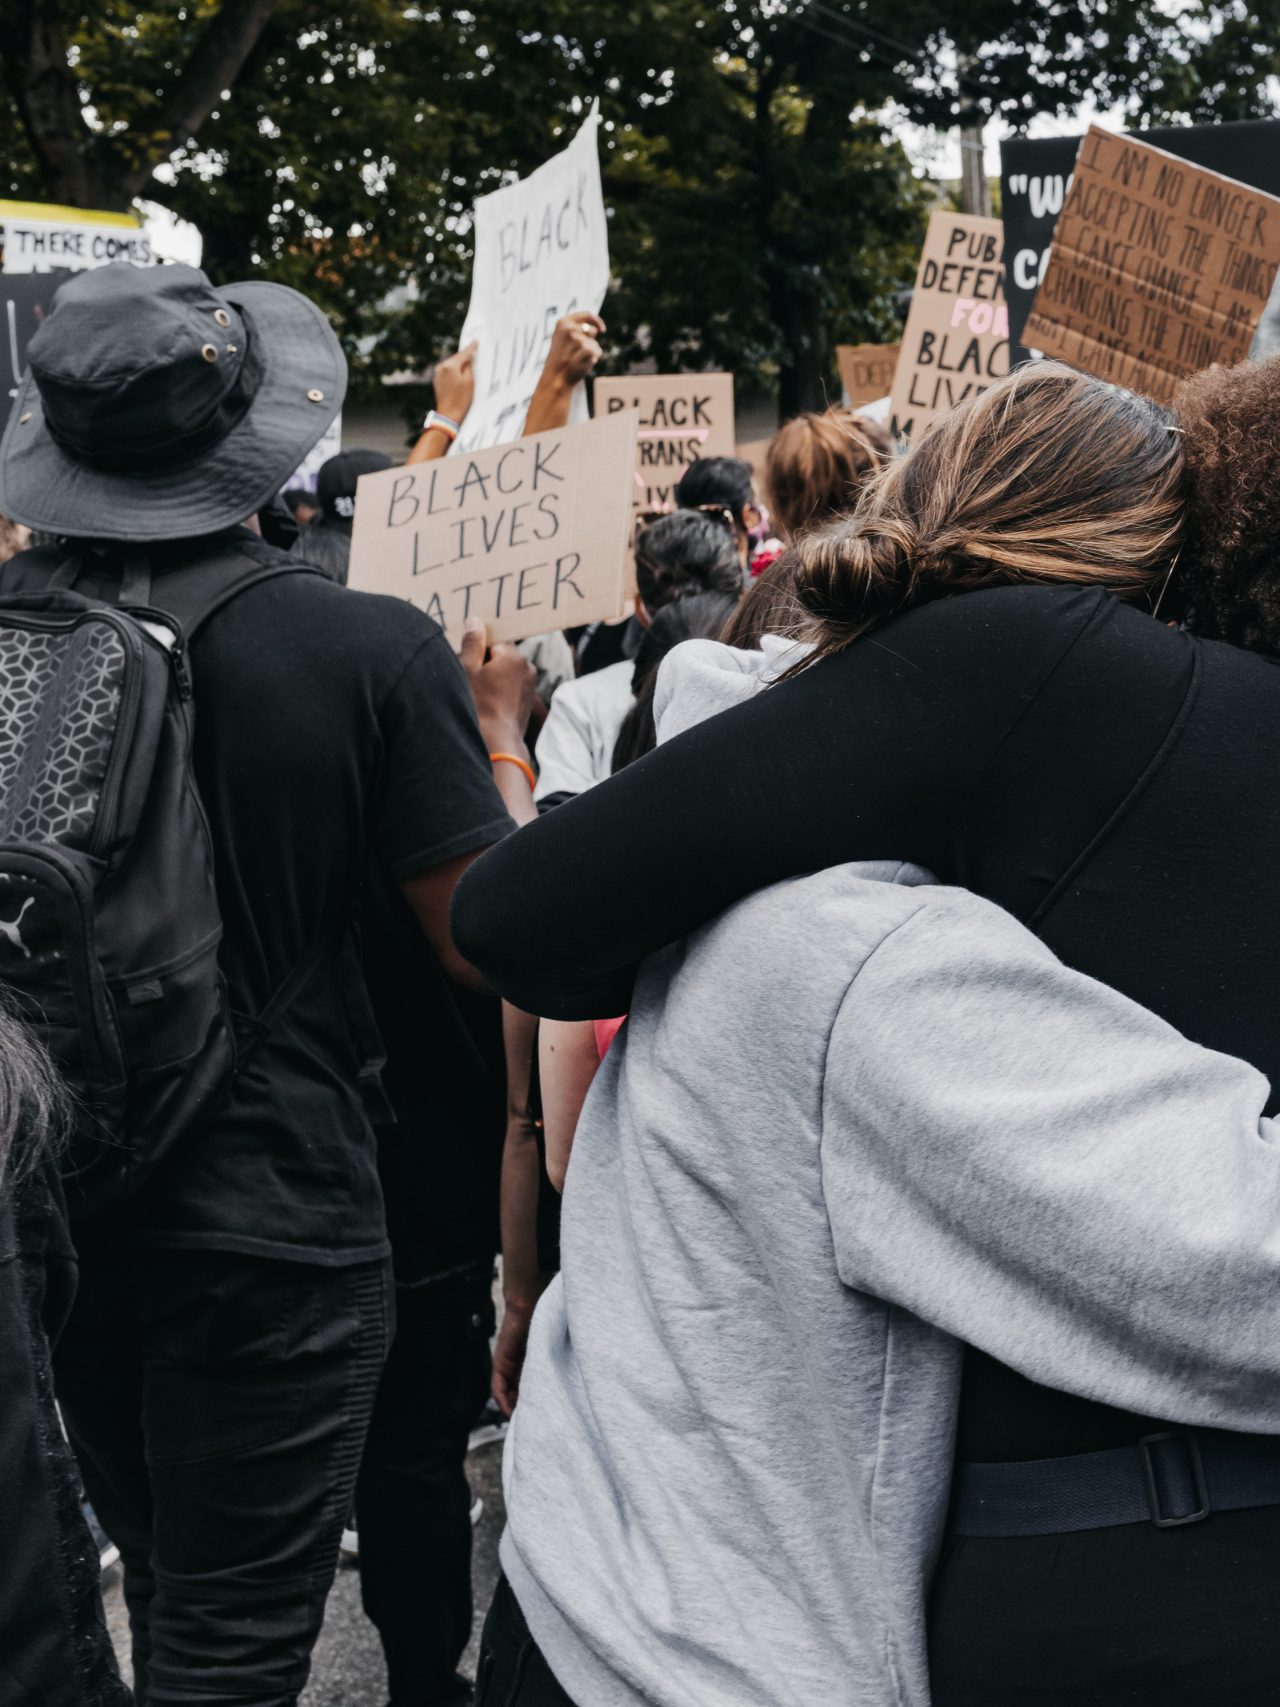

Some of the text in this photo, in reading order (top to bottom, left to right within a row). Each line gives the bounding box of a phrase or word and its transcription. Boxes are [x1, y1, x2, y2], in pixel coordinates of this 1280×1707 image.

[500, 171, 589, 293] BLACK
[1080, 132, 1269, 248] I AM NO LONGER
[14, 230, 85, 257] THERE
[92, 234, 151, 264] COMES
[1065, 178, 1279, 301] ACCEPTING THE THINGS
[1043, 262, 1133, 336] CHANGING
[1138, 304, 1173, 353] THE
[1132, 255, 1203, 319] CHANGE
[1203, 288, 1221, 330] I
[1219, 300, 1254, 344] AM
[387, 443, 564, 528] BLACK
[412, 494, 560, 576] LIVES
[407, 552, 584, 631] ATTER
